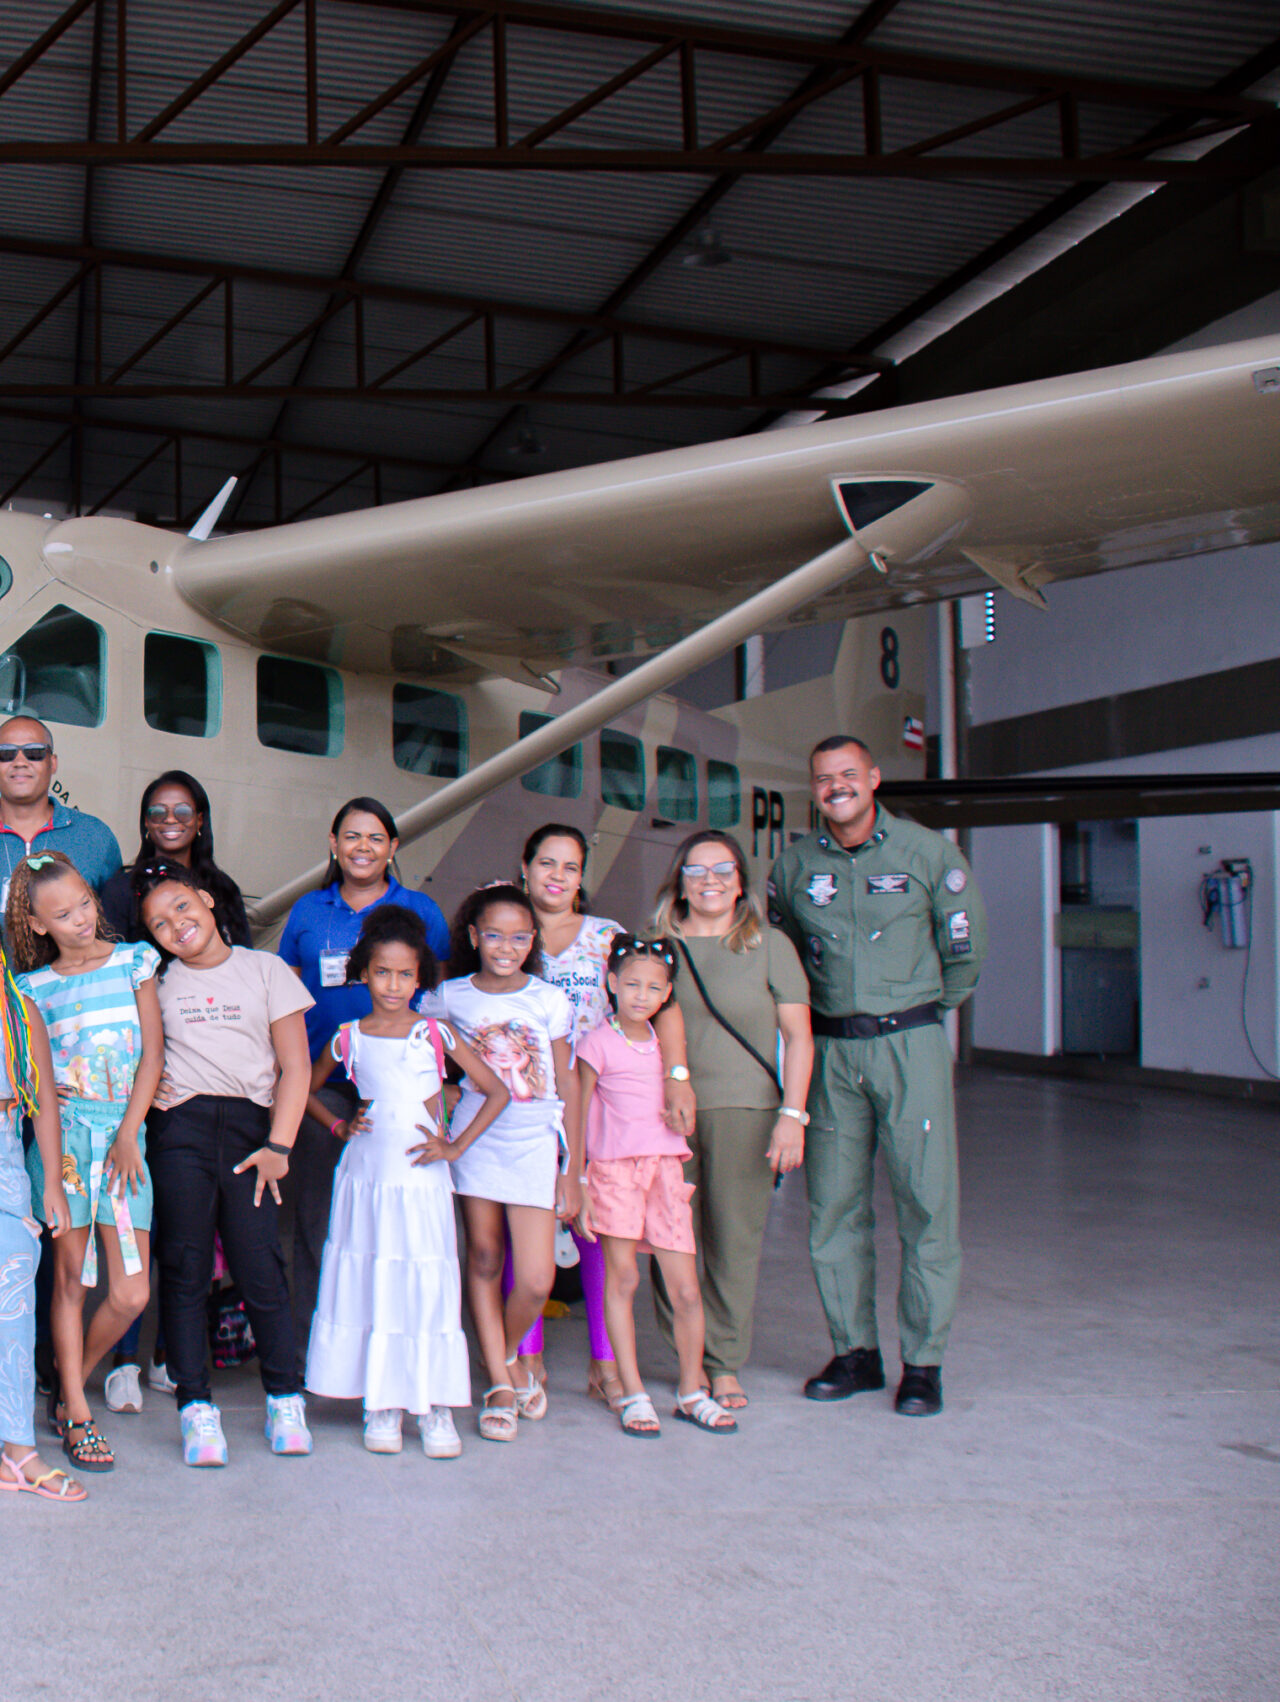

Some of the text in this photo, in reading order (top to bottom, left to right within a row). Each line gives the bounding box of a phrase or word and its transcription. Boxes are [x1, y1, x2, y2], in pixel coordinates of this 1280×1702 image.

[880, 626, 899, 689] 8
[752, 785, 820, 859] PR-
[572, 971, 599, 988] Social
